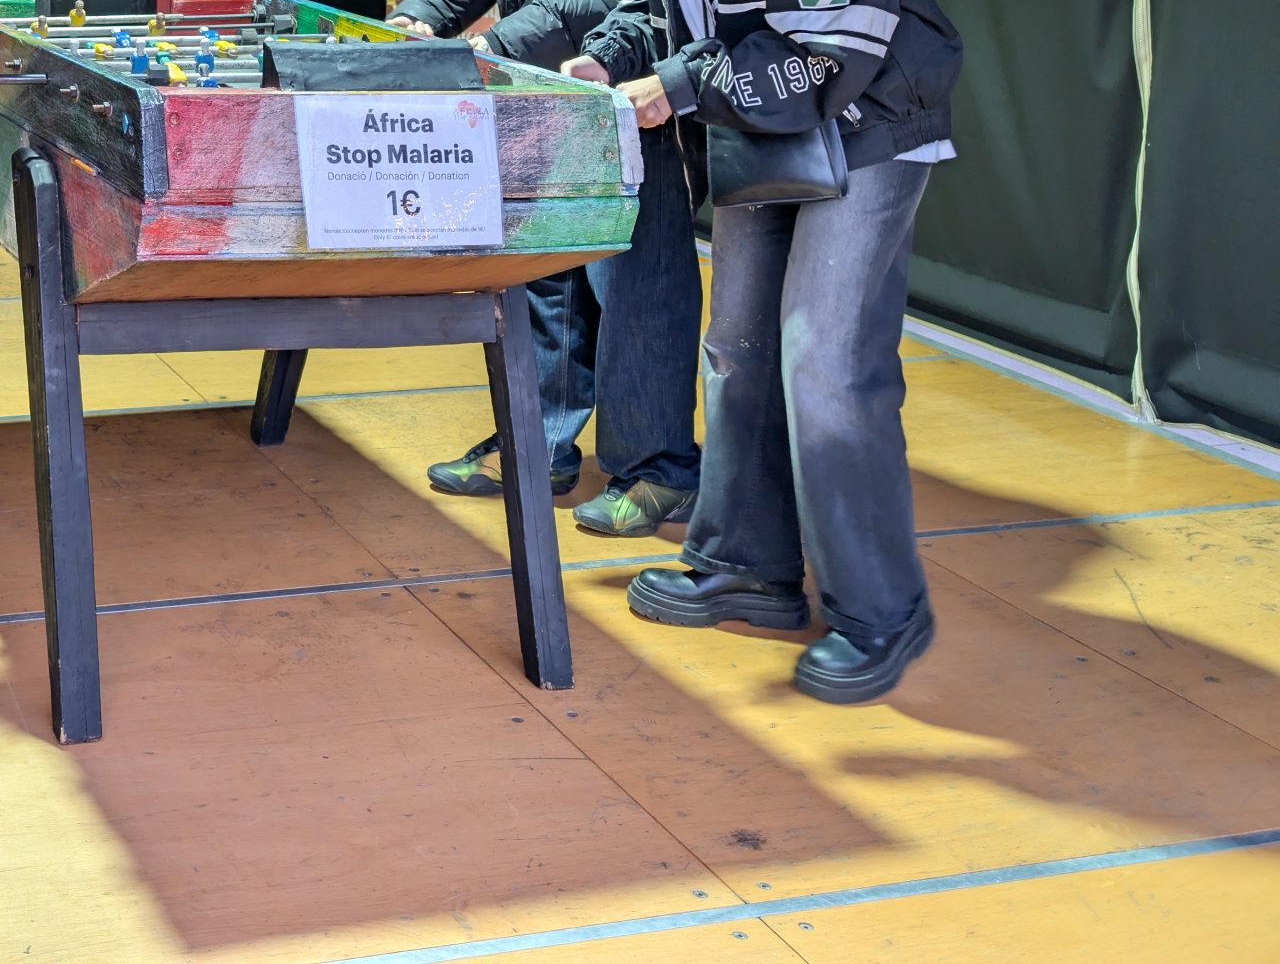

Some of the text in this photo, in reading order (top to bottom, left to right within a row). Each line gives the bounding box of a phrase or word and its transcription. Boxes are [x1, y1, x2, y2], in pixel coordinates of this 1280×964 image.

[363, 108, 434, 134] África
[326, 143, 474, 168] Stop Malaria
[327, 170, 367, 181] Donació
[375, 170, 419, 181] Donación
[428, 170, 470, 181] Donation
[386, 189, 421, 217] 1€
